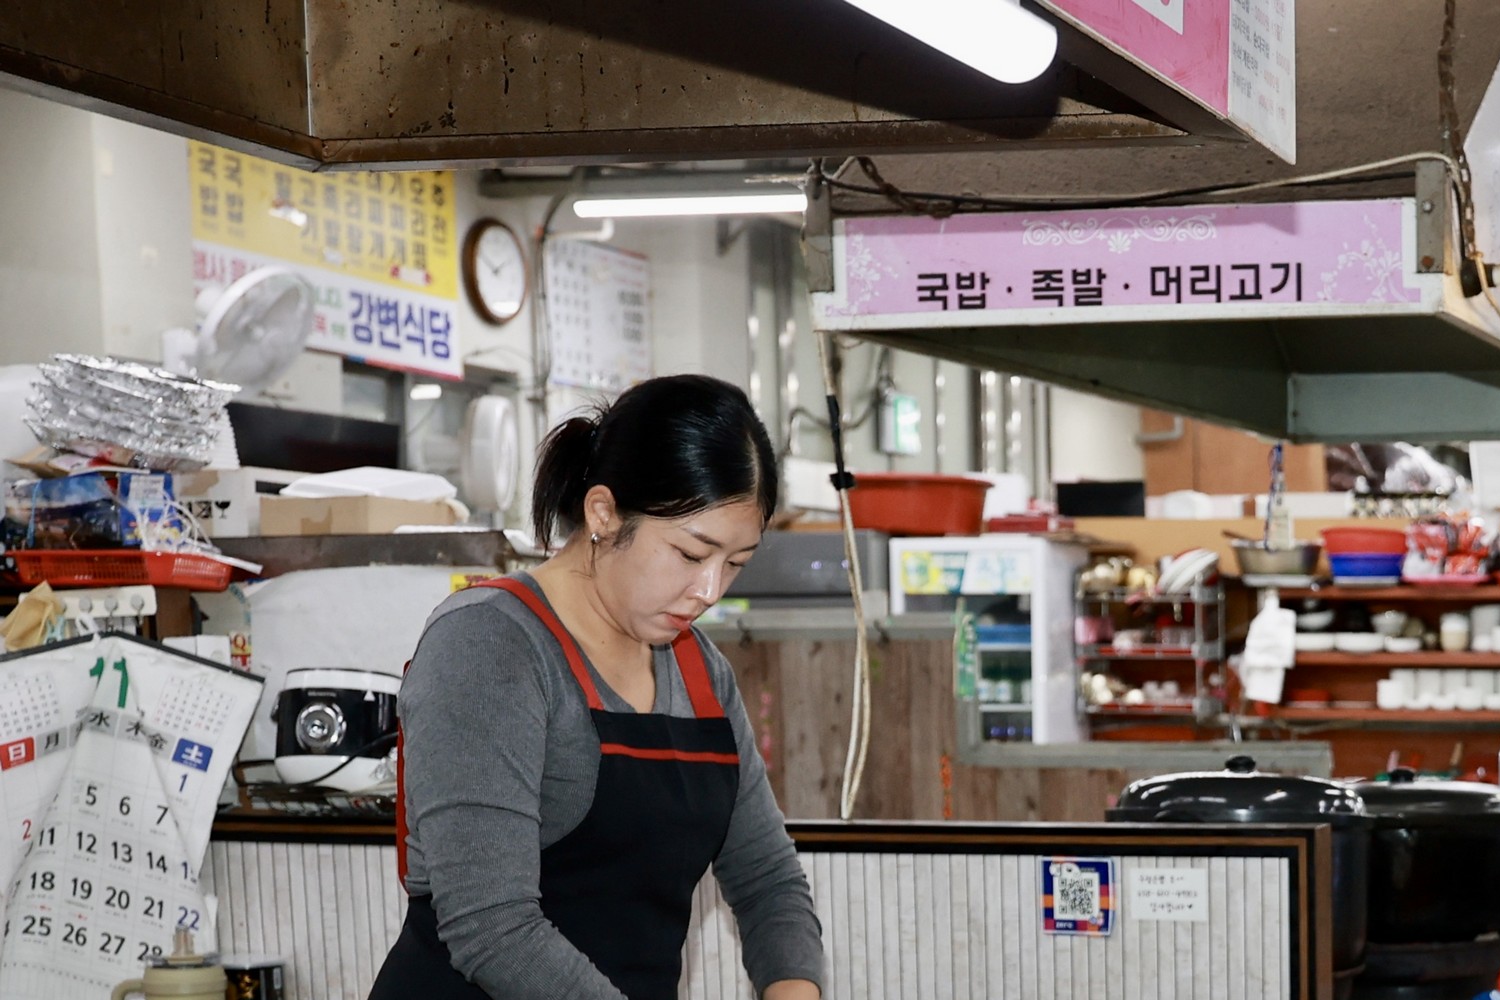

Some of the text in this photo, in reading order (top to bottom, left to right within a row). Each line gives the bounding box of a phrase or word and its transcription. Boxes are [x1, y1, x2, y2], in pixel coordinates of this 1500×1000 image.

[916, 262, 1302, 311] 국밥 족발 머리고기
[349, 289, 451, 360] 강변식당
[9, 711, 204, 764] 日 月 水 木 金 土
[178, 773, 189, 793] 1
[22, 785, 170, 841] 2 5 6 7
[76, 830, 98, 854] 12
[111, 840, 133, 864] 13
[146, 851, 169, 874] 14
[30, 871, 201, 931] 18 19 20 21 22
[22, 914, 52, 937] 25
[62, 922, 88, 947] 26
[99, 932, 126, 956] 27
